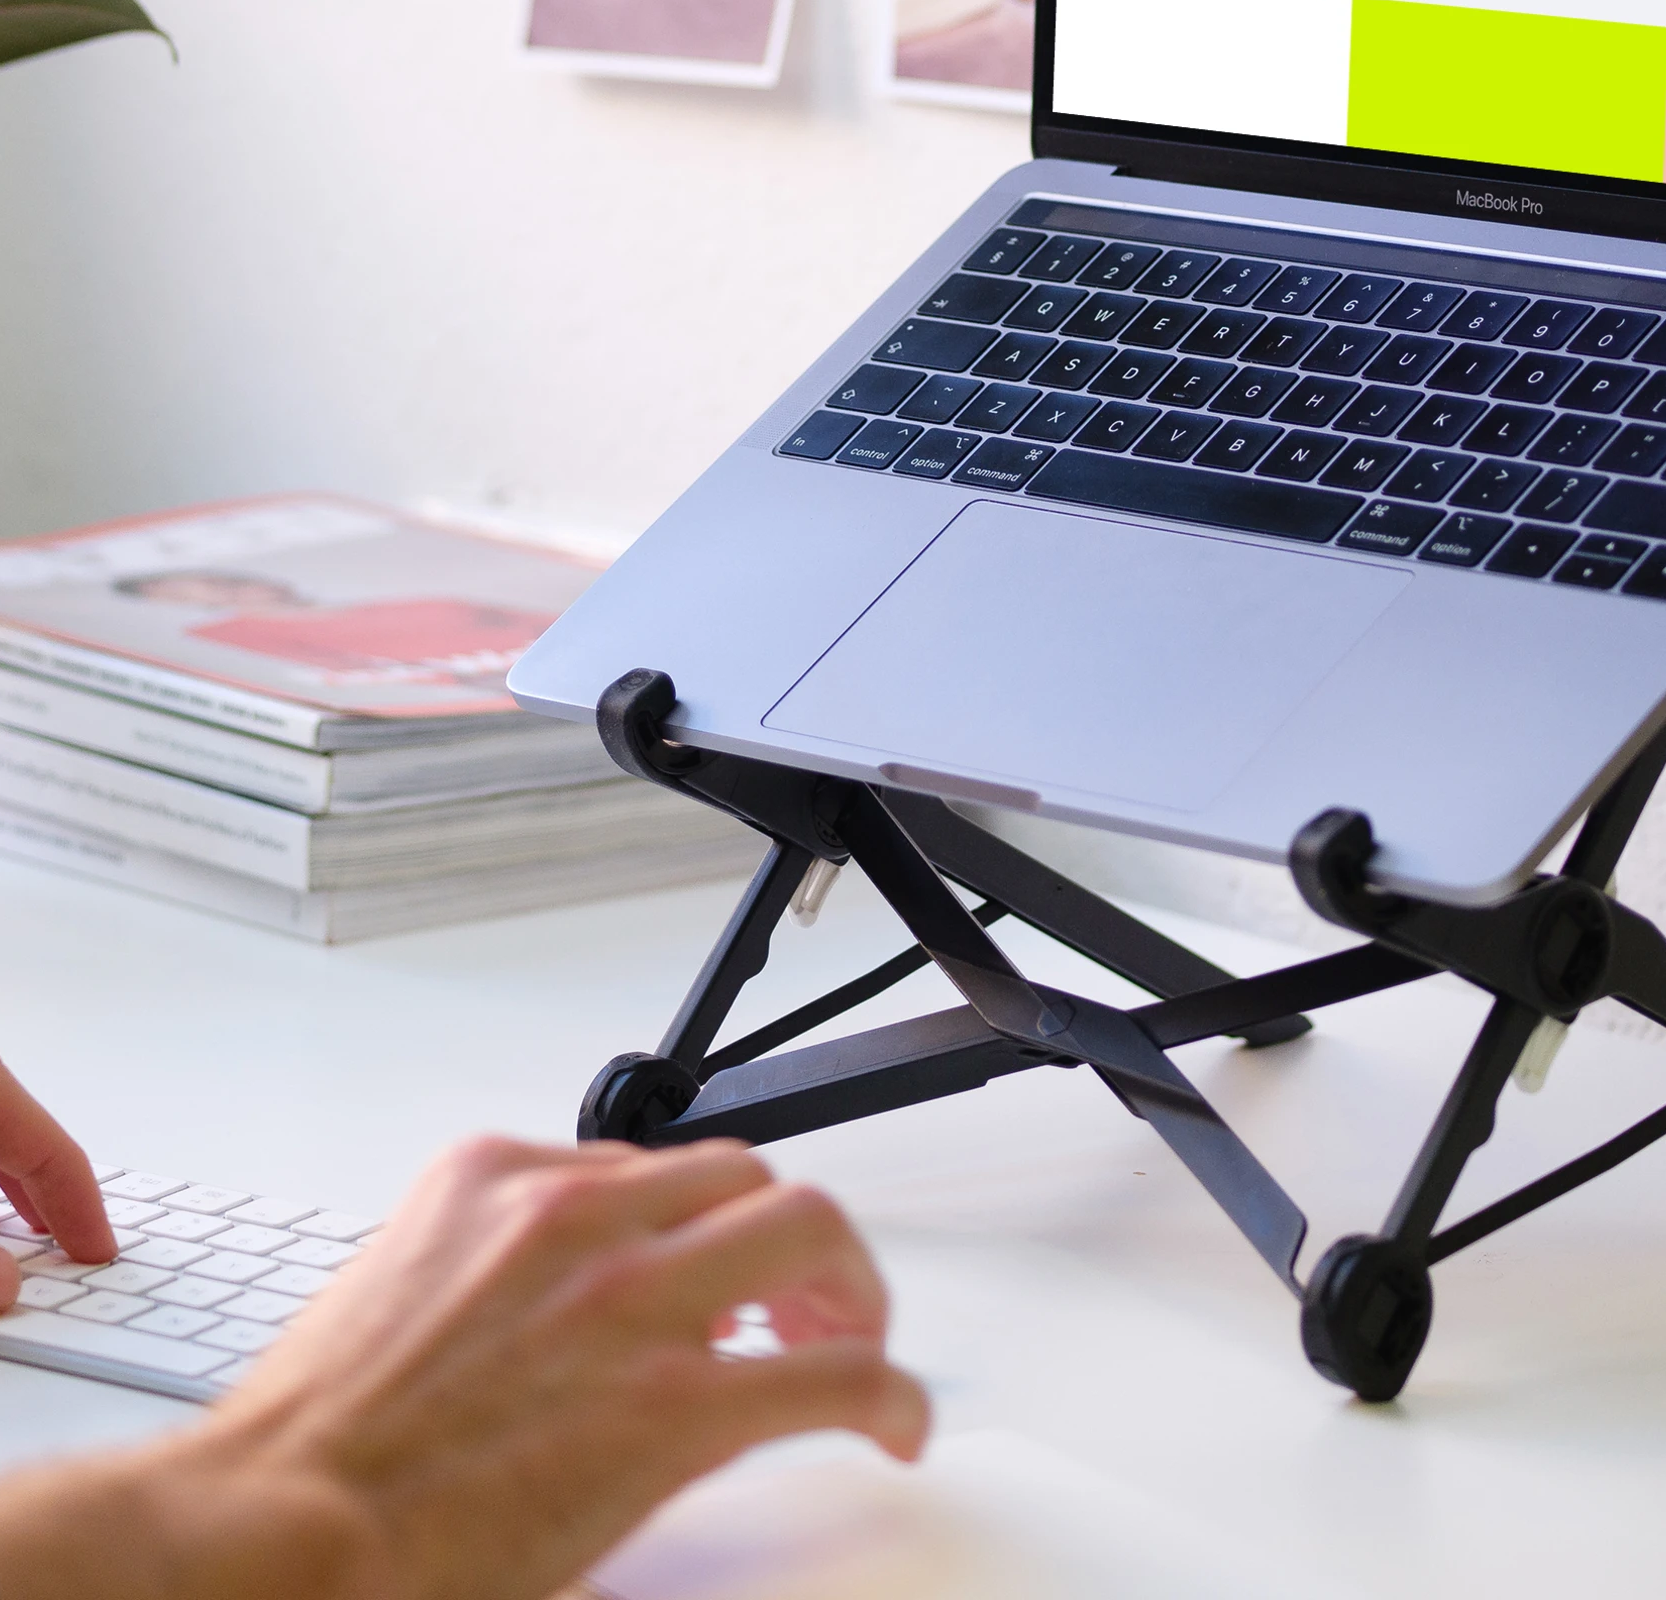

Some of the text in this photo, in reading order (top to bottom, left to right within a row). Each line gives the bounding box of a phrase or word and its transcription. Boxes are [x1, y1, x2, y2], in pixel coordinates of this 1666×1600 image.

[1455, 189, 1543, 215] MacBook Pro
[1048, 259, 1061, 272] 1
[1103, 266, 1120, 280] 2
[1161, 274, 1178, 287] 3
[1222, 283, 1237, 295] 4
[1281, 291, 1298, 304] 5
[1343, 299, 1359, 312] 6
[1406, 307, 1423, 320] 7
[1468, 316, 1485, 329] 8
[1532, 325, 1549, 338] 9
[1597, 334, 1614, 347] 0
[1037, 301, 1054, 315] Q
[1093, 309, 1115, 322] W
[1153, 317, 1171, 331] E
[1212, 326, 1230, 339] R
[1277, 334, 1293, 348] T
[1338, 343, 1354, 356] Y
[1398, 352, 1417, 366] U
[1465, 361, 1478, 375] I
[1527, 370, 1545, 384] O
[1591, 379, 1610, 393] P
[988, 400, 1007, 414] Z
[1046, 410, 1066, 424] X
[1107, 420, 1125, 433] C
[1170, 428, 1187, 442] V
[1228, 438, 1246, 452] B
[1290, 448, 1311, 462] N
[1352, 457, 1375, 472] M
[1004, 350, 1021, 363] A
[1064, 358, 1081, 371] S
[1121, 366, 1140, 380] D
[1183, 375, 1201, 388] F
[1245, 385, 1262, 398] G
[1305, 394, 1325, 408] H
[1370, 404, 1387, 417] J
[1432, 413, 1452, 427] K
[1497, 422, 1510, 436] L
[792, 436, 1472, 556] fn control option command command option
